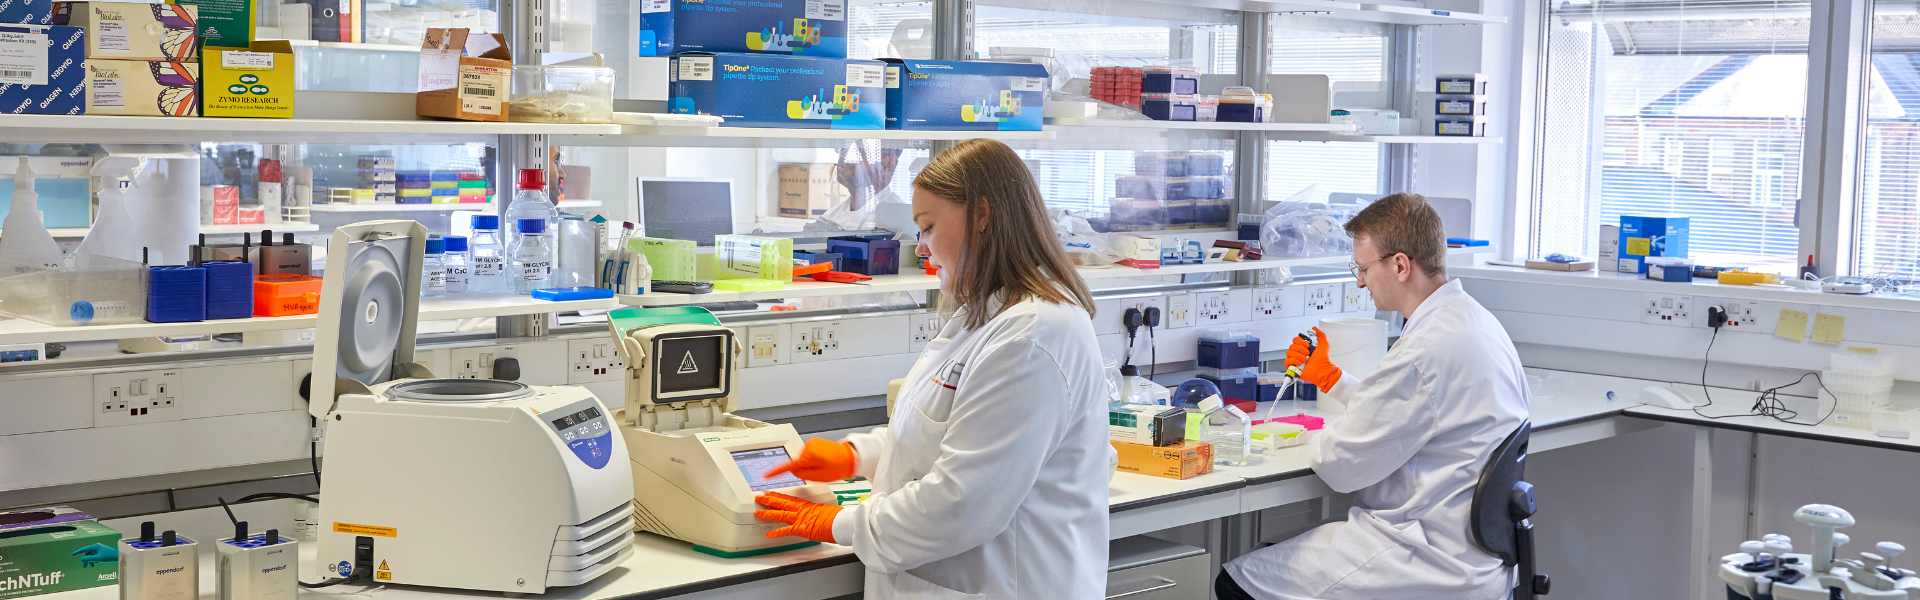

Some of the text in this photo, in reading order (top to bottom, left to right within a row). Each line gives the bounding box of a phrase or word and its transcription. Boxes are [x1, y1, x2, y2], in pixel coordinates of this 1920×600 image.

[62, 28, 84, 50] QIAGEN
[51, 58, 72, 80] QIAGEN
[790, 67, 824, 75] professional
[40, 87, 62, 108] QIAGEN
[156, 566, 184, 575] eppendorf
[262, 564, 286, 574] eppendorf
[98, 572, 117, 580] Ansell
